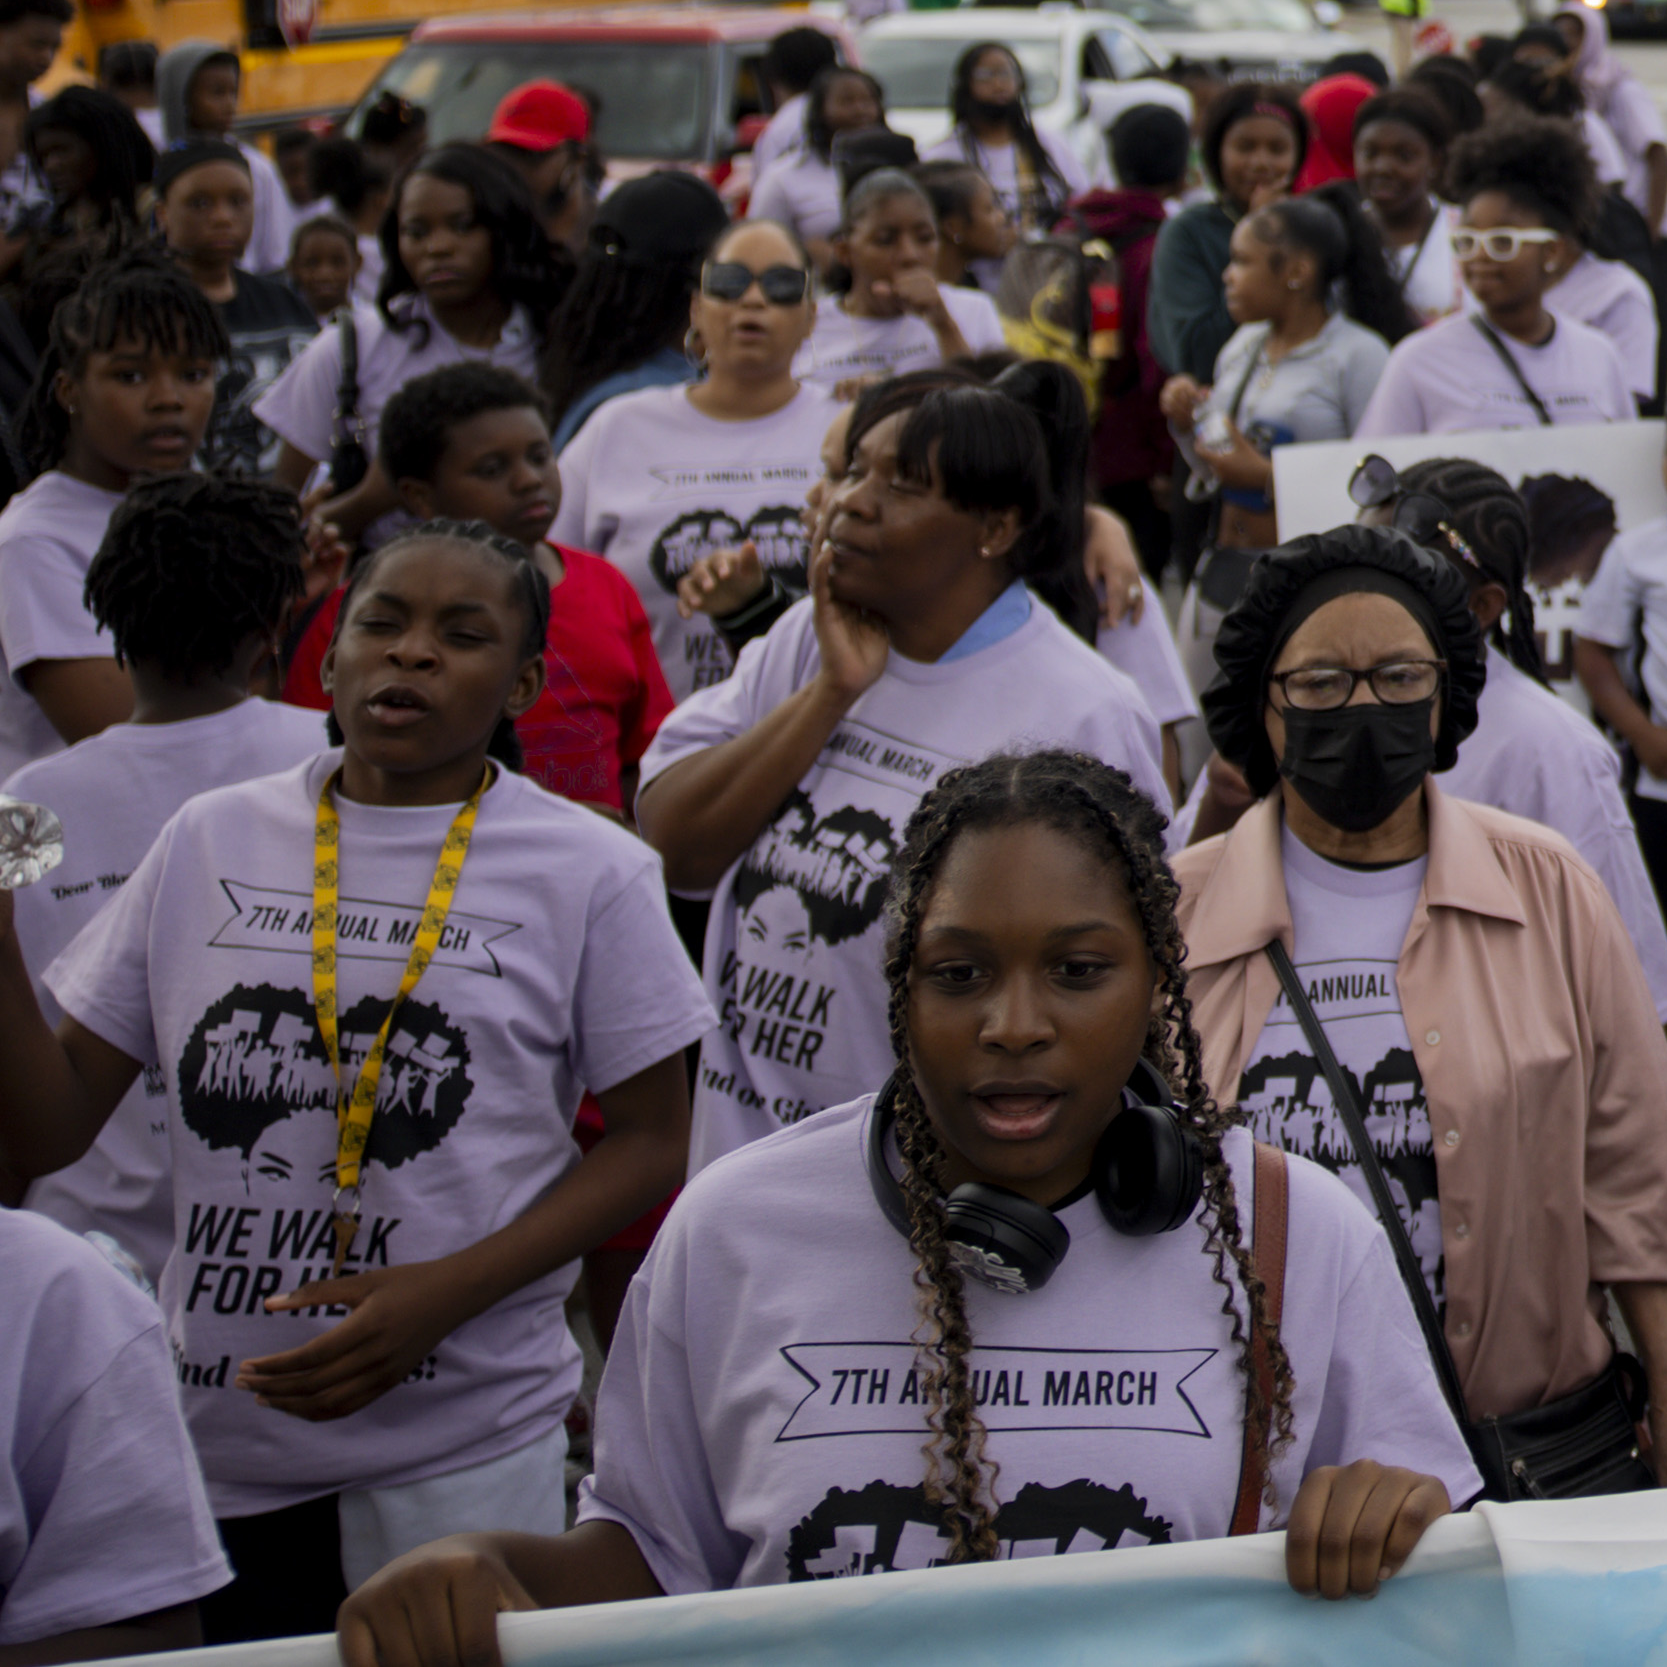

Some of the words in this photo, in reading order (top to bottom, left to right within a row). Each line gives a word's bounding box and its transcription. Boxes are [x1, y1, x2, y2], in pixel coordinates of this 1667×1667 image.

[876, 748, 935, 781] MARCH
[246, 905, 290, 932] 7TH
[387, 918, 471, 952] MACH
[740, 965, 837, 1028] WALK
[1308, 974, 1390, 1005] ANNUAL
[750, 1017, 824, 1073] HER
[184, 1203, 262, 1259] WE
[267, 1208, 402, 1267] WALK
[185, 1262, 283, 1316] FOR
[829, 1368, 890, 1406] 7TH
[1042, 1370, 1158, 1407] MARCH
